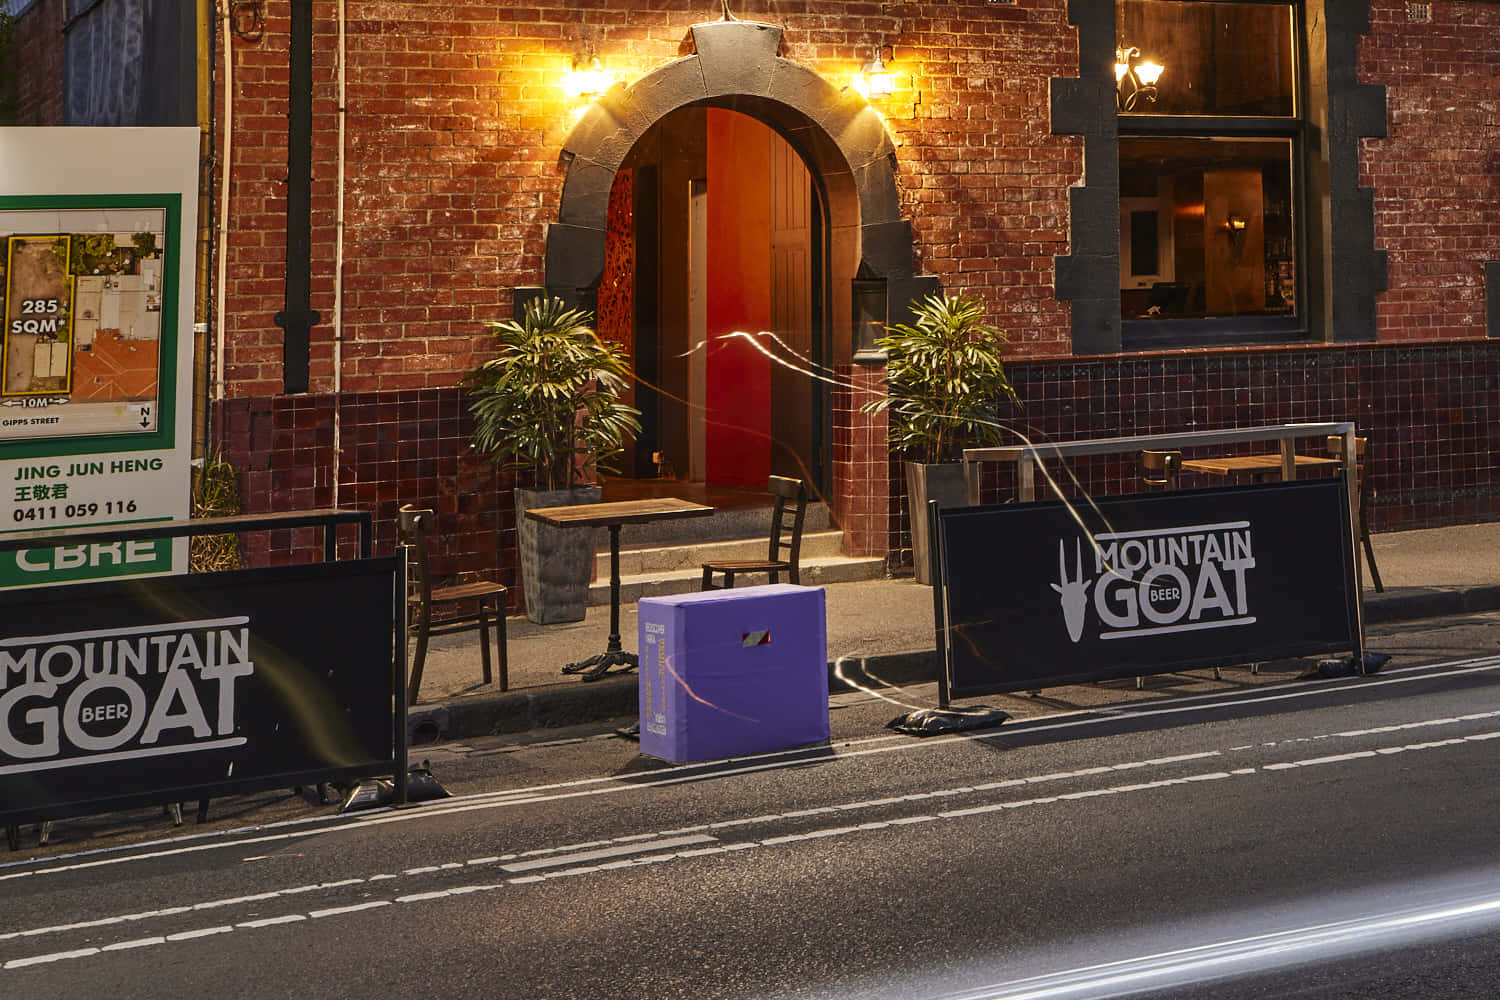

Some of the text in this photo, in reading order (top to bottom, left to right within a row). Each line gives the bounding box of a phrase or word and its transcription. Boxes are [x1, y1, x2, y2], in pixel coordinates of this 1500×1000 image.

[22, 300, 58, 314] 285
[2, 417, 59, 426] GIPPS STREET
[141, 407, 150, 416] N
[14, 458, 163, 481] JING JUN HENG
[13, 483, 69, 502] 王敬君
[13, 500, 137, 522] 0411 059 116
[1095, 530, 1254, 573] MOUNTAIN
[1094, 557, 1256, 629] GOAT
[1150, 586, 1181, 602] BEER
[0, 627, 250, 689] MOUNTAIN
[0, 660, 254, 759] GOAT
[82, 702, 129, 724] BEER
